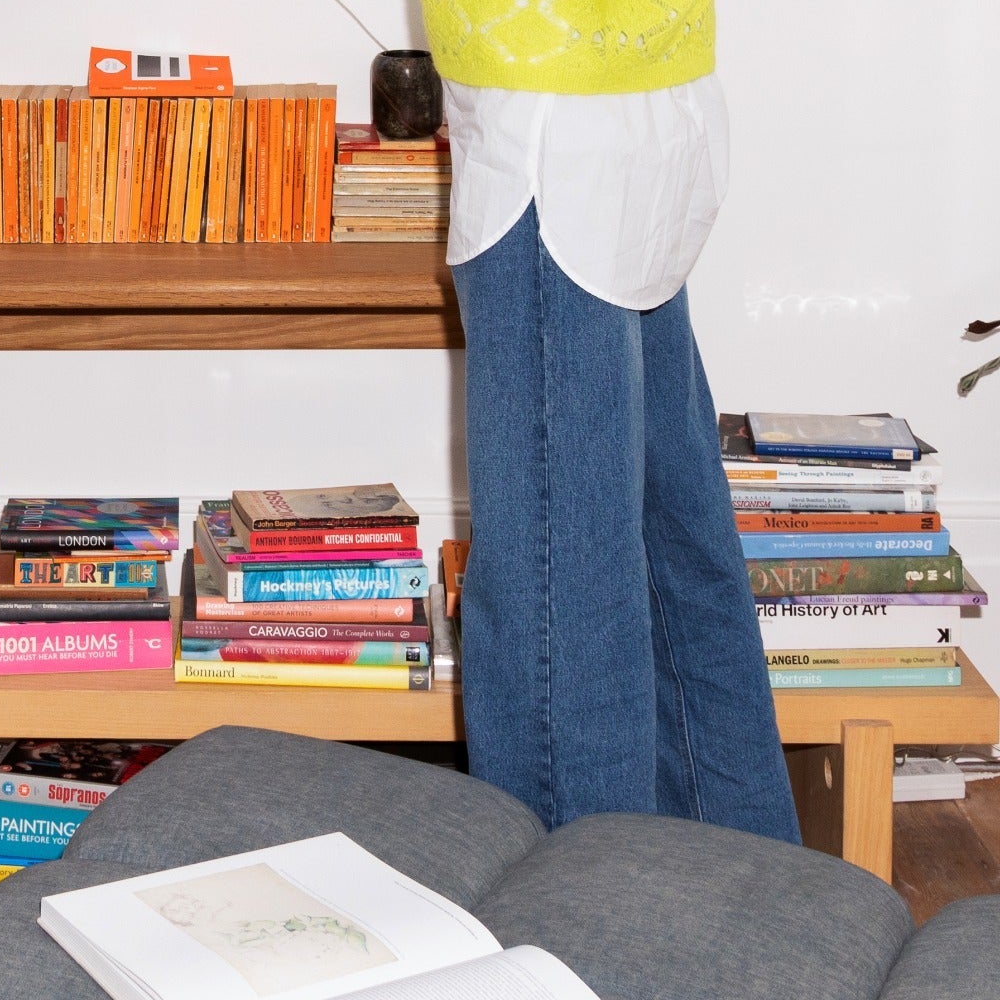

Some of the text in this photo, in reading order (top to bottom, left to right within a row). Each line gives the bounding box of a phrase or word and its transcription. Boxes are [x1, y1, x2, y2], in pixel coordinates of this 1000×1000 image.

[778, 470, 855, 478] Seeing Through Paintings
[256, 520, 274, 528] John
[274, 520, 297, 528] Berger
[762, 516, 809, 529] Mexico
[919, 516, 933, 530] RA
[58, 535, 107, 547] LONDON
[255, 532, 404, 547] ANTHONY BOURDAIN KITCHEN CONFIDENTIAL
[874, 539, 933, 552] Decorate
[19, 562, 62, 584] THE
[64, 562, 115, 584] ART
[260, 579, 391, 596] Hockney's Pictures
[205, 602, 236, 610] Drawing
[808, 595, 895, 605] Lucian Freud paintings
[205, 608, 246, 616] Masterclass
[756, 603, 888, 620] rld History of Art
[248, 625, 395, 638] CARAVAGGIO The Complete Works
[41, 633, 119, 652] ALBUMS
[38, 653, 58, 661] HEAR
[59, 652, 87, 660] BEFORE
[88, 651, 105, 659] YOU
[225, 646, 249, 654] PATHS
[265, 648, 318, 656] ABSTRACTION
[766, 655, 935, 666] LANGELO Hugo Chapman
[184, 664, 236, 679] Bonnard
[775, 672, 822, 685] Portraits
[48, 783, 107, 806] Sopranos
[6, 833, 20, 842] SEE
[21, 834, 50, 845] BEFORE
[51, 836, 70, 846] YOU
